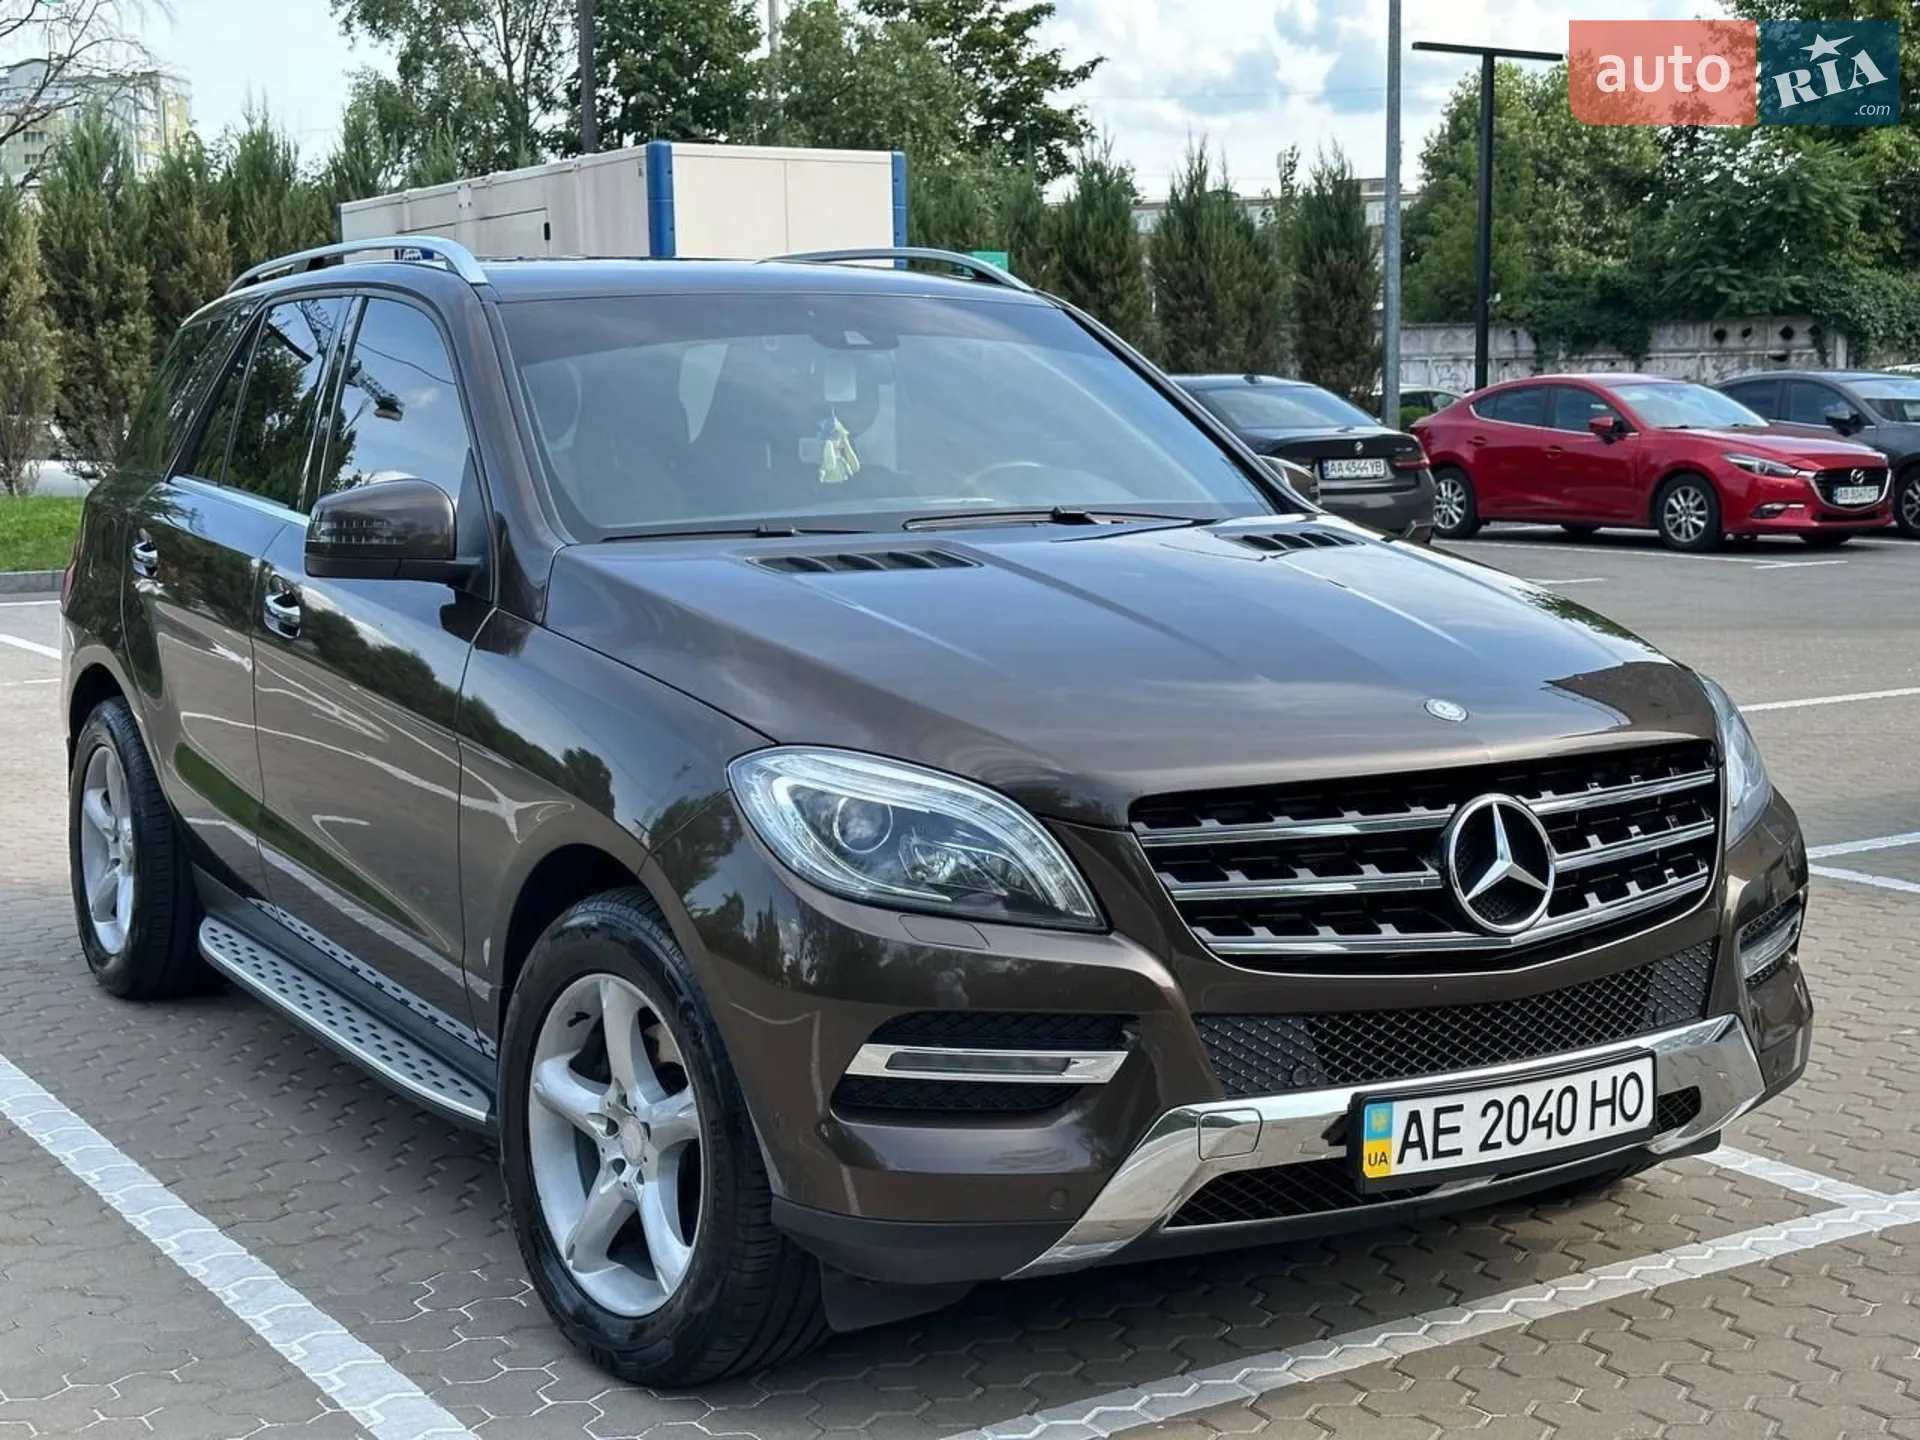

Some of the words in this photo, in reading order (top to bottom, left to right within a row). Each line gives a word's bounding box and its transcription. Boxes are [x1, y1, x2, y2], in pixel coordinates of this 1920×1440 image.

[1397, 1103, 1465, 1165] AE
[1478, 1085, 1578, 1153] 2040
[1590, 1071, 1644, 1131] HO
[1367, 1151, 1389, 1167] UA
